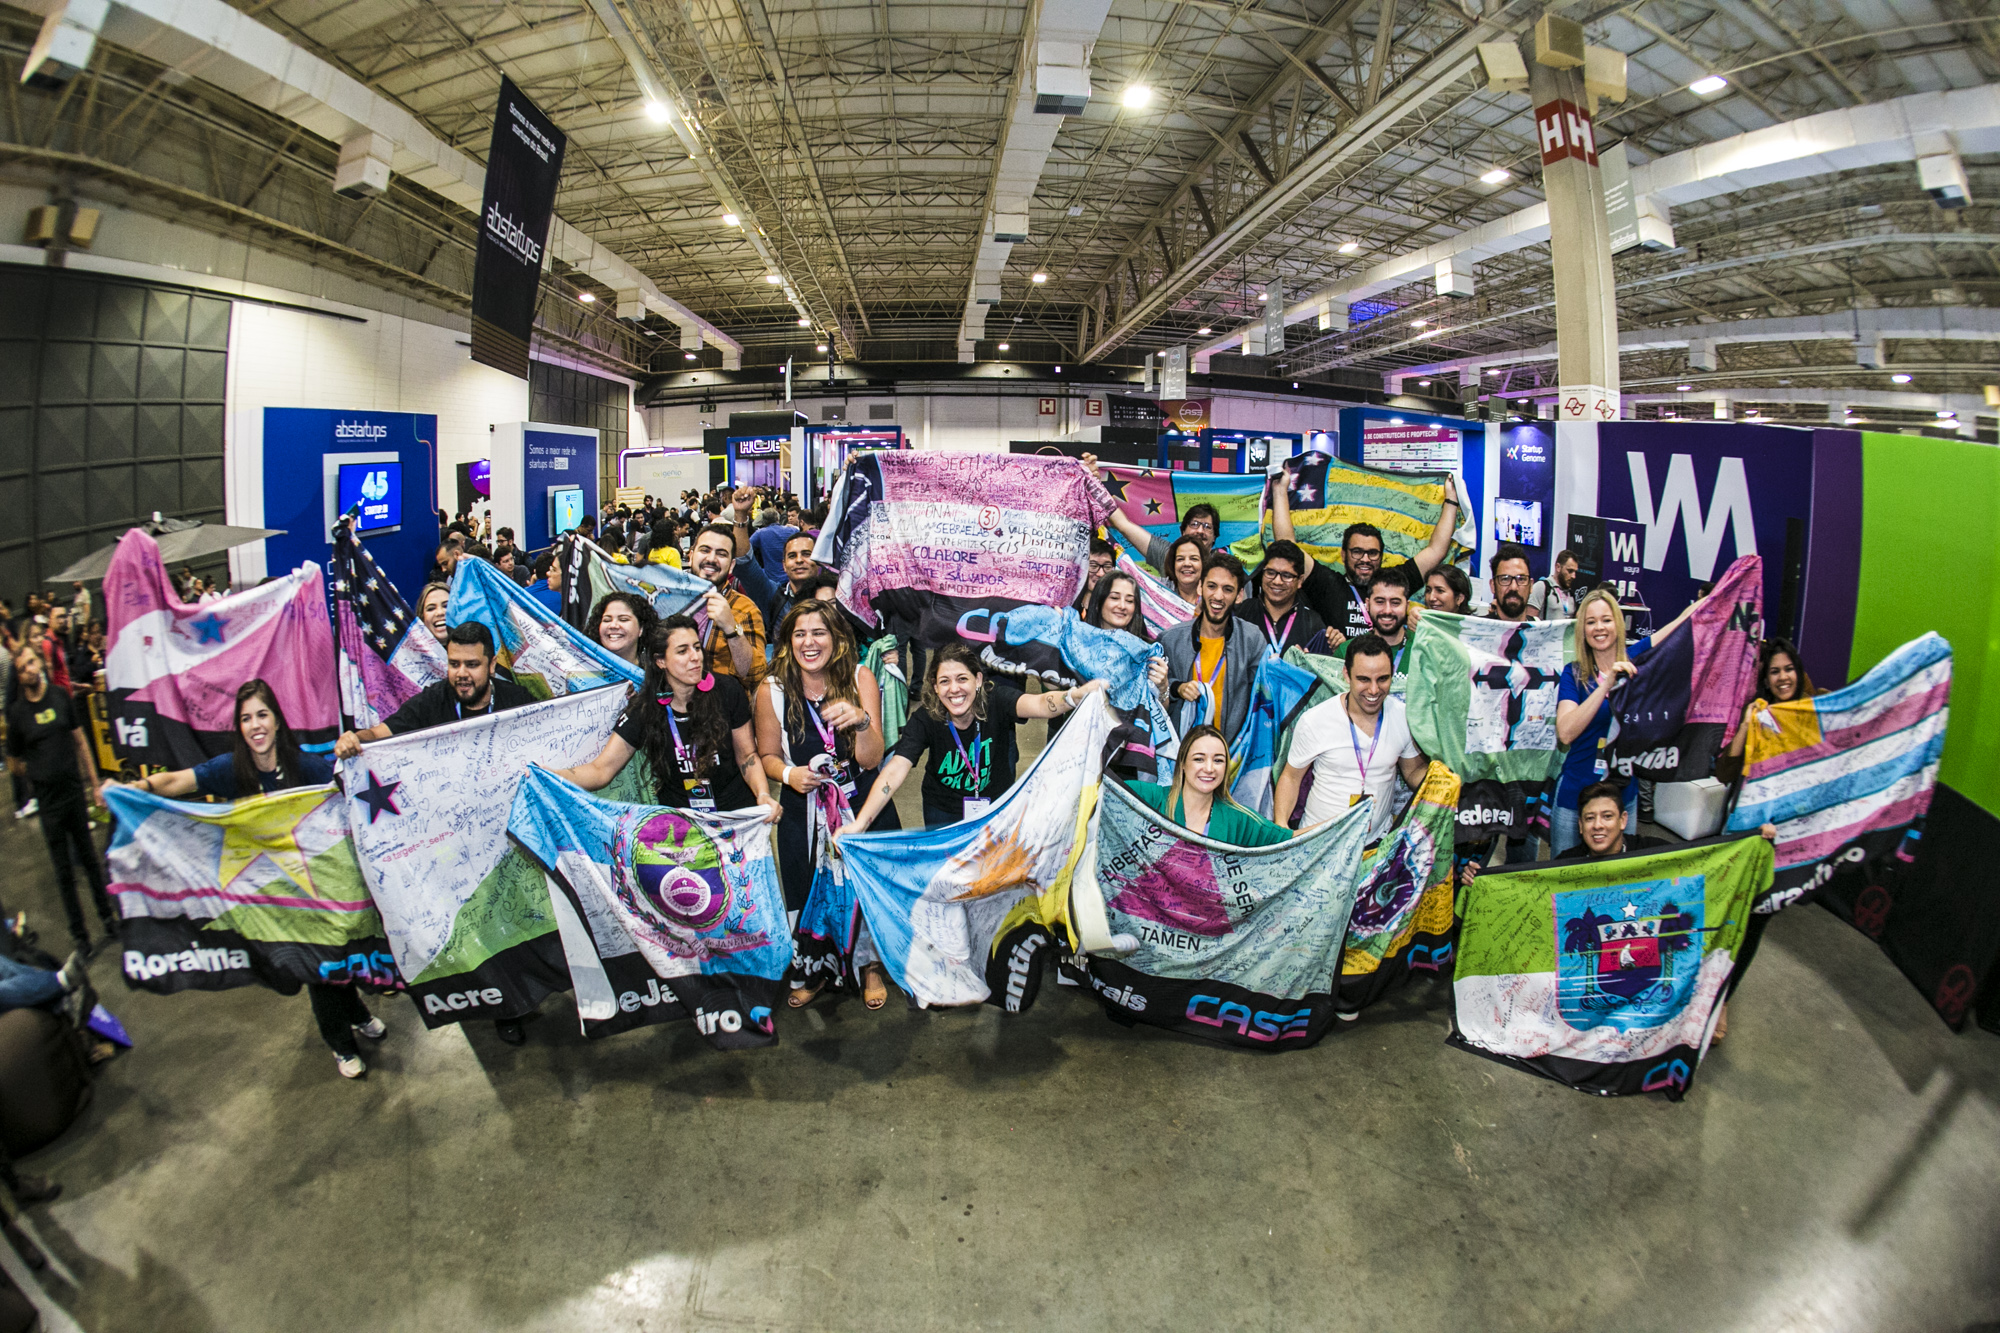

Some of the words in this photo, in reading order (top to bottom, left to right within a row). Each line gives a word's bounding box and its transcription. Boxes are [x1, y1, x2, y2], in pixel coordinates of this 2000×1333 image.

[509, 101, 526, 126] Somos
[511, 123, 530, 146] startups
[1539, 112, 1565, 153] H
[1566, 111, 1594, 154] H
[1041, 400, 1054, 412] H
[1088, 401, 1100, 414] E
[1373, 431, 1406, 440] CONSTRUTECHS
[1410, 430, 1439, 438] PROPTECHS
[529, 444, 544, 455] Somos
[549, 446, 561, 456] maior
[561, 446, 571, 456] rede
[1521, 444, 1543, 456] Startup
[1521, 453, 1546, 463] Genome
[529, 459, 548, 471] startups
[361, 471, 389, 500] 45
[912, 546, 979, 565] COLABORE
[944, 568, 1008, 586] SALVADOR
[1623, 566, 1640, 575] wayra
[1102, 824, 1163, 882] LIBERTAS
[690, 938, 707, 956] RIO
[715, 934, 759, 949] JANEIRO
[1140, 926, 1201, 951] TAMEN
[123, 941, 250, 981] Roraima
[318, 950, 406, 990] CAS
[423, 987, 503, 1015] Acre
[1185, 994, 1311, 1042] CASE
